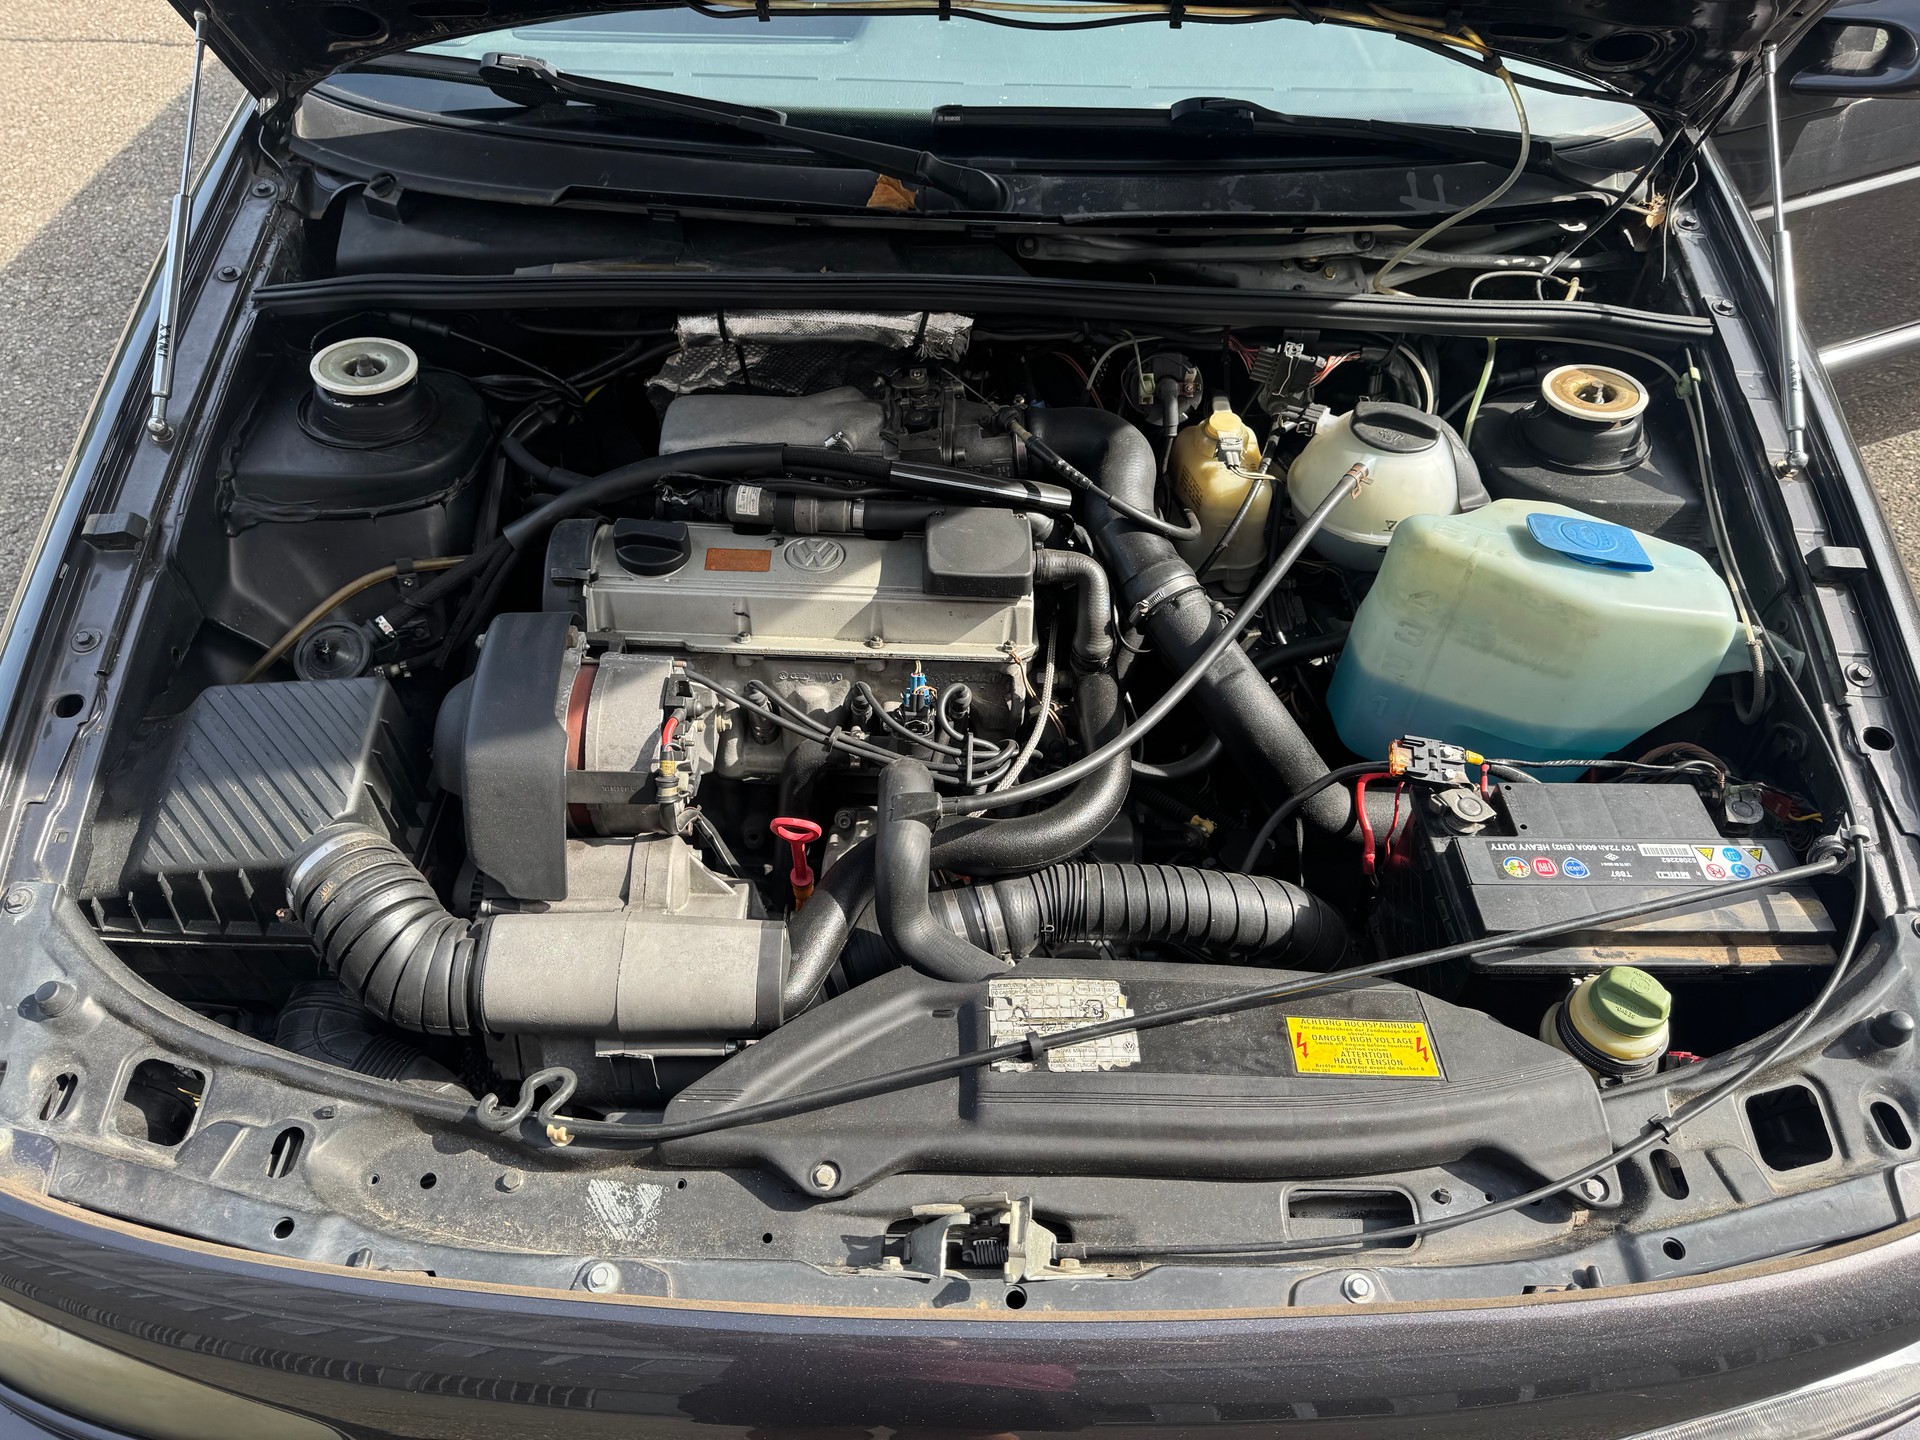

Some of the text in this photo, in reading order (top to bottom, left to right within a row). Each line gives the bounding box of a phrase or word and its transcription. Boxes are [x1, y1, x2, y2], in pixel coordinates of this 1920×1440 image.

[1537, 862, 1553, 872] FIAT
[1300, 1018, 1416, 1029] ACHTUNG HOCHSPANNUNG
